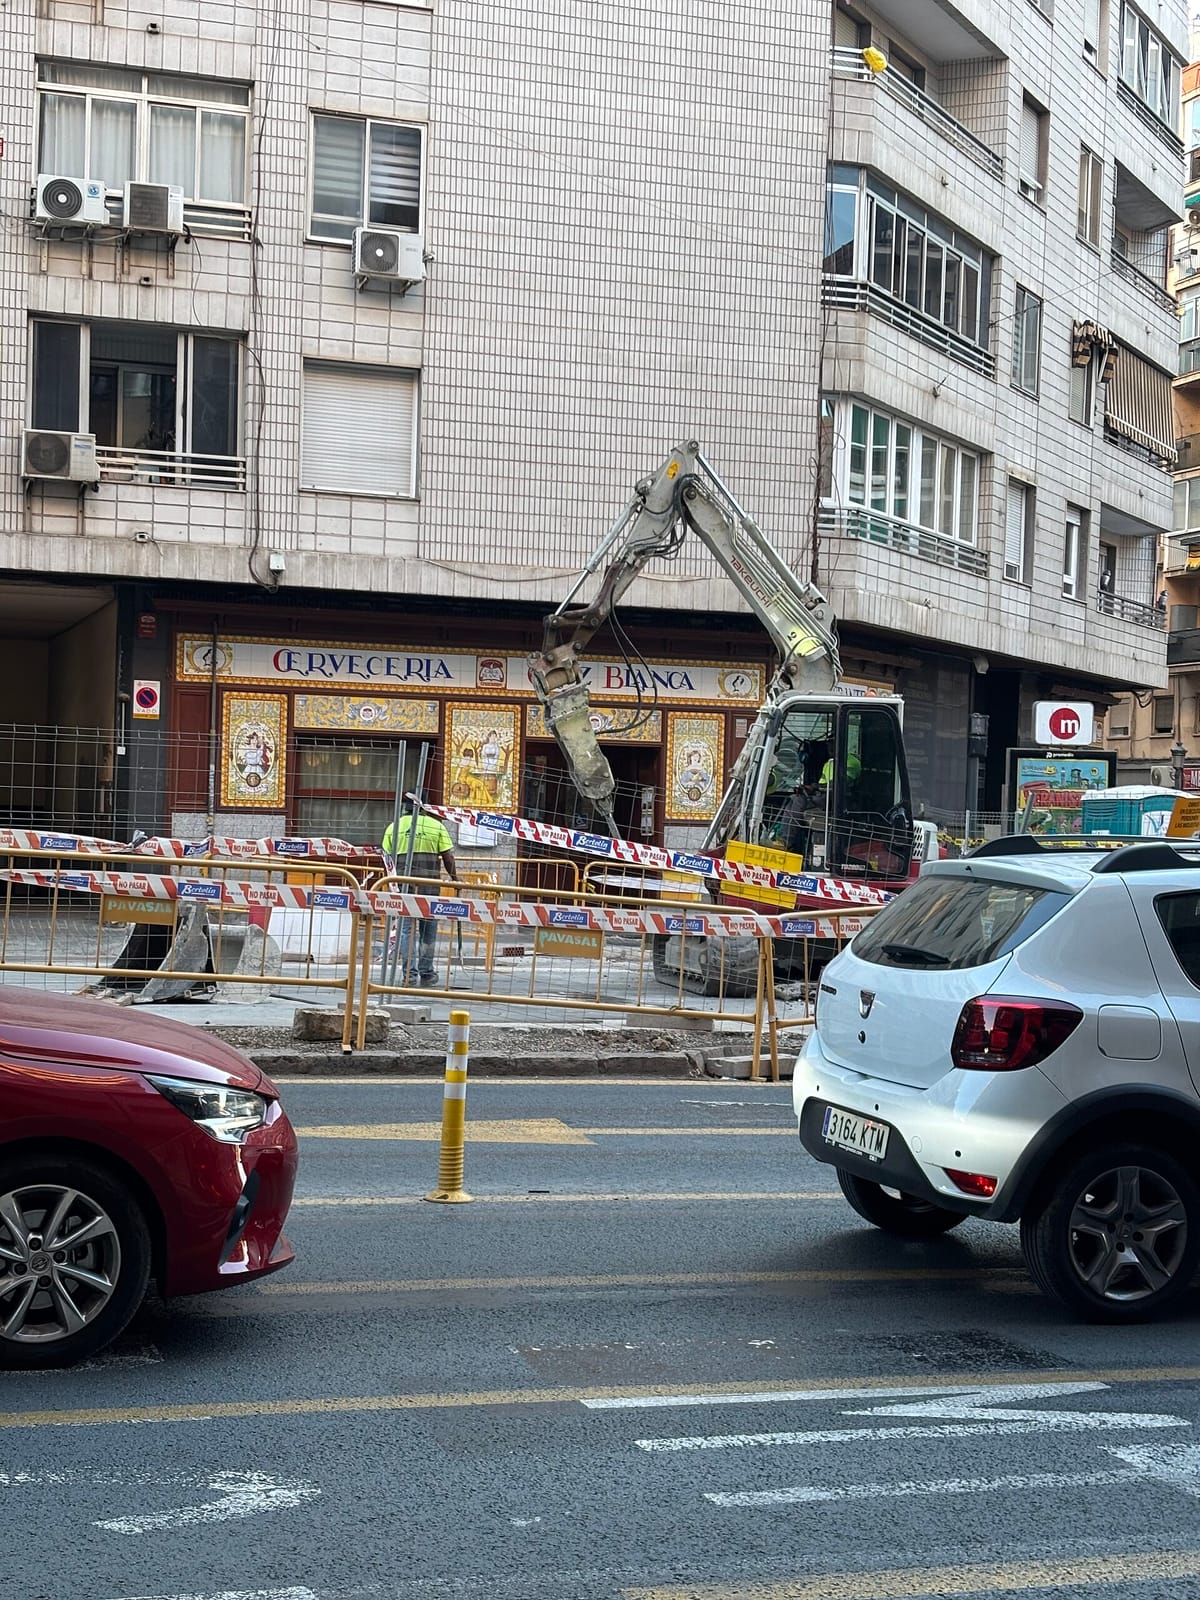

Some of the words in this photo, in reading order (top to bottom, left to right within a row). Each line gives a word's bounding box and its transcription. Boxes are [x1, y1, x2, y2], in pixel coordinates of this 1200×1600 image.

[273, 648, 454, 683] CERVECERIA
[602, 665, 696, 692] BLANCA
[541, 829, 549, 838] NO
[550, 831, 567, 841] PASAR
[640, 850, 648, 859] NO
[649, 852, 666, 863] PASAR
[742, 869, 751, 878] NO
[752, 871, 770, 882] PASAR
[118, 879, 127, 889] NO
[128, 880, 147, 891] PASAR
[249, 890, 258, 899] NO
[259, 891, 277, 901] PASAR
[376, 900, 385, 909] NO
[386, 901, 402, 910] PASAR
[504, 910, 521, 919] PASAR
[613, 916, 622, 925] NO
[623, 917, 639, 926] PASAR
[729, 921, 738, 930] NO
[739, 922, 755, 931] PASAR
[845, 924, 860, 932] PASAR
[539, 930, 598, 948] PAVASAL
[830, 1113, 857, 1145] 3164
[860, 1123, 886, 1154] KTM
